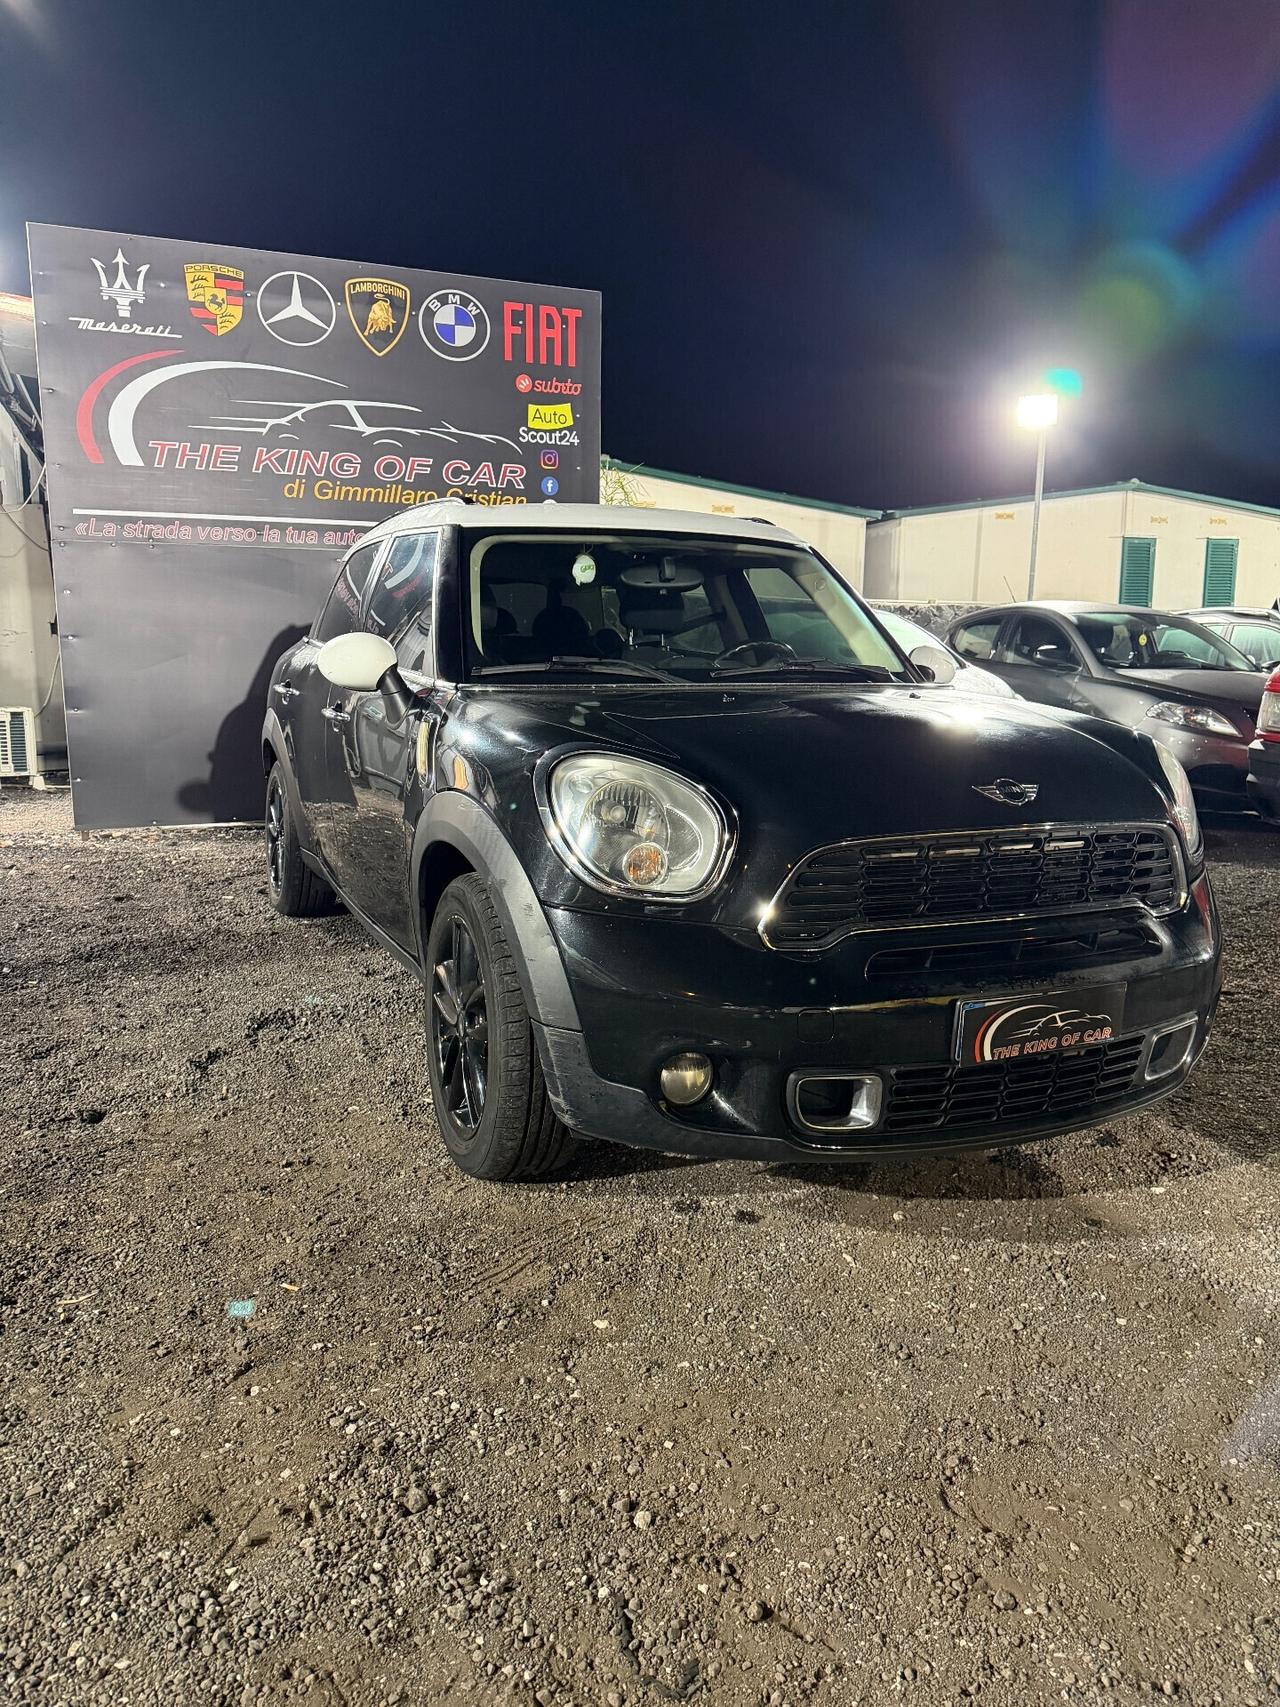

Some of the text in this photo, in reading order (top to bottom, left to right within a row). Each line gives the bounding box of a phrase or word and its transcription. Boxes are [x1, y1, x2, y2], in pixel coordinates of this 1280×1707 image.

[185, 264, 244, 279] PORSCHE
[350, 281, 406, 300] LAMBORGHINI
[68, 316, 183, 339] Maserati
[503, 301, 582, 367] FIAT
[533, 377, 582, 396] subito
[531, 408, 568, 425] Auto
[518, 427, 580, 446] Scout24
[148, 440, 527, 489] THE KING OF CAR
[283, 479, 305, 499] di
[313, 480, 438, 504] Gimmillaro
[122, 520, 192, 540] strada
[197, 526, 257, 543] verso
[262, 525, 281, 543] la
[286, 527, 318, 545] tua
[992, 1044, 1021, 1060] THE
[1024, 1036, 1058, 1054] KING
[1061, 1032, 1081, 1047] OF
[1083, 1027, 1112, 1042] CAR
